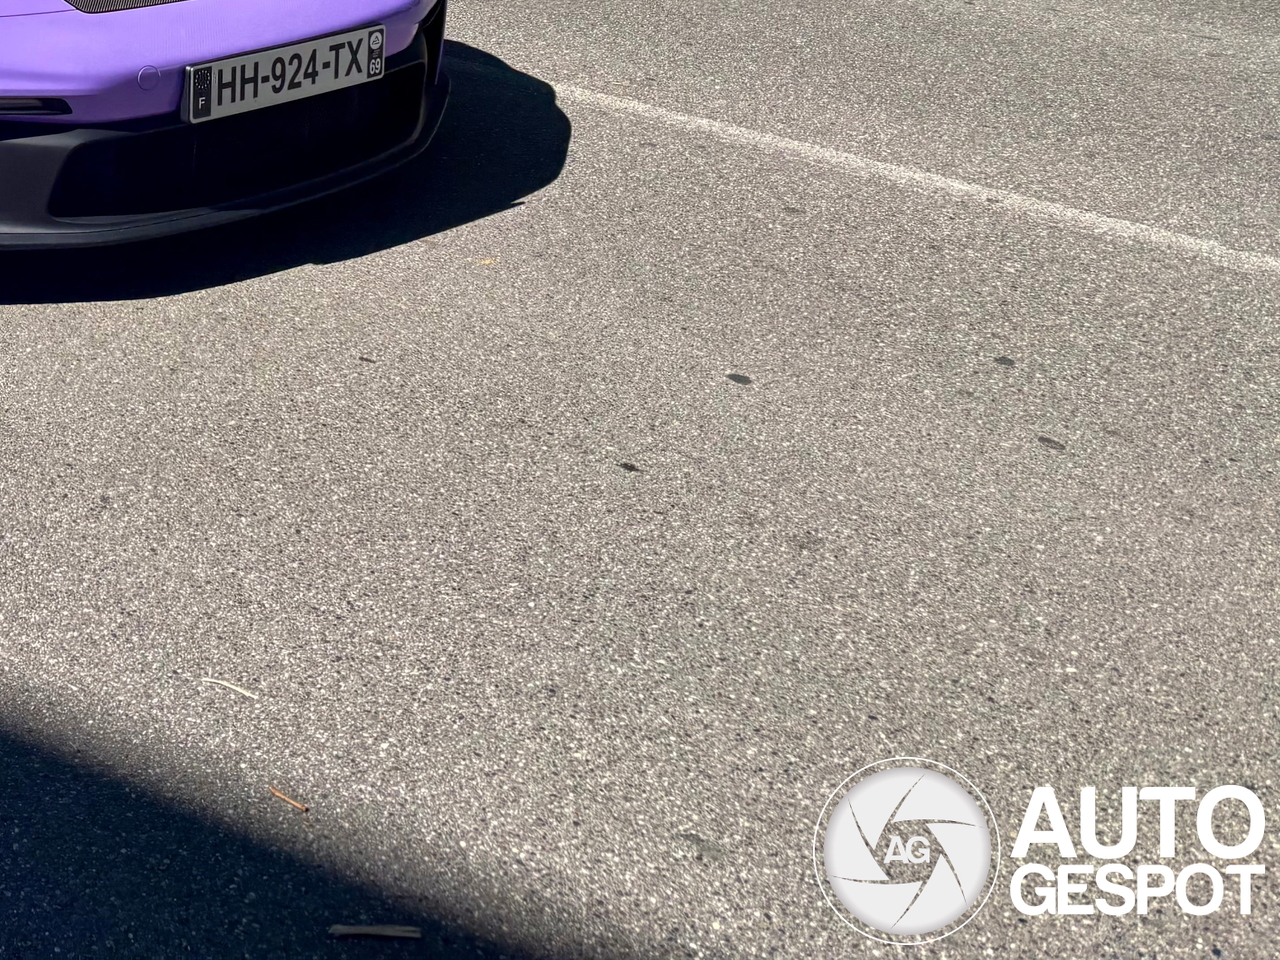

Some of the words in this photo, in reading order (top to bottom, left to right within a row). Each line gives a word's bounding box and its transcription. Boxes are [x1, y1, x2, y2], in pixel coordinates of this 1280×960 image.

[217, 38, 364, 106] HH-924-TX
[370, 58, 381, 74] 69
[198, 97, 206, 109] F
